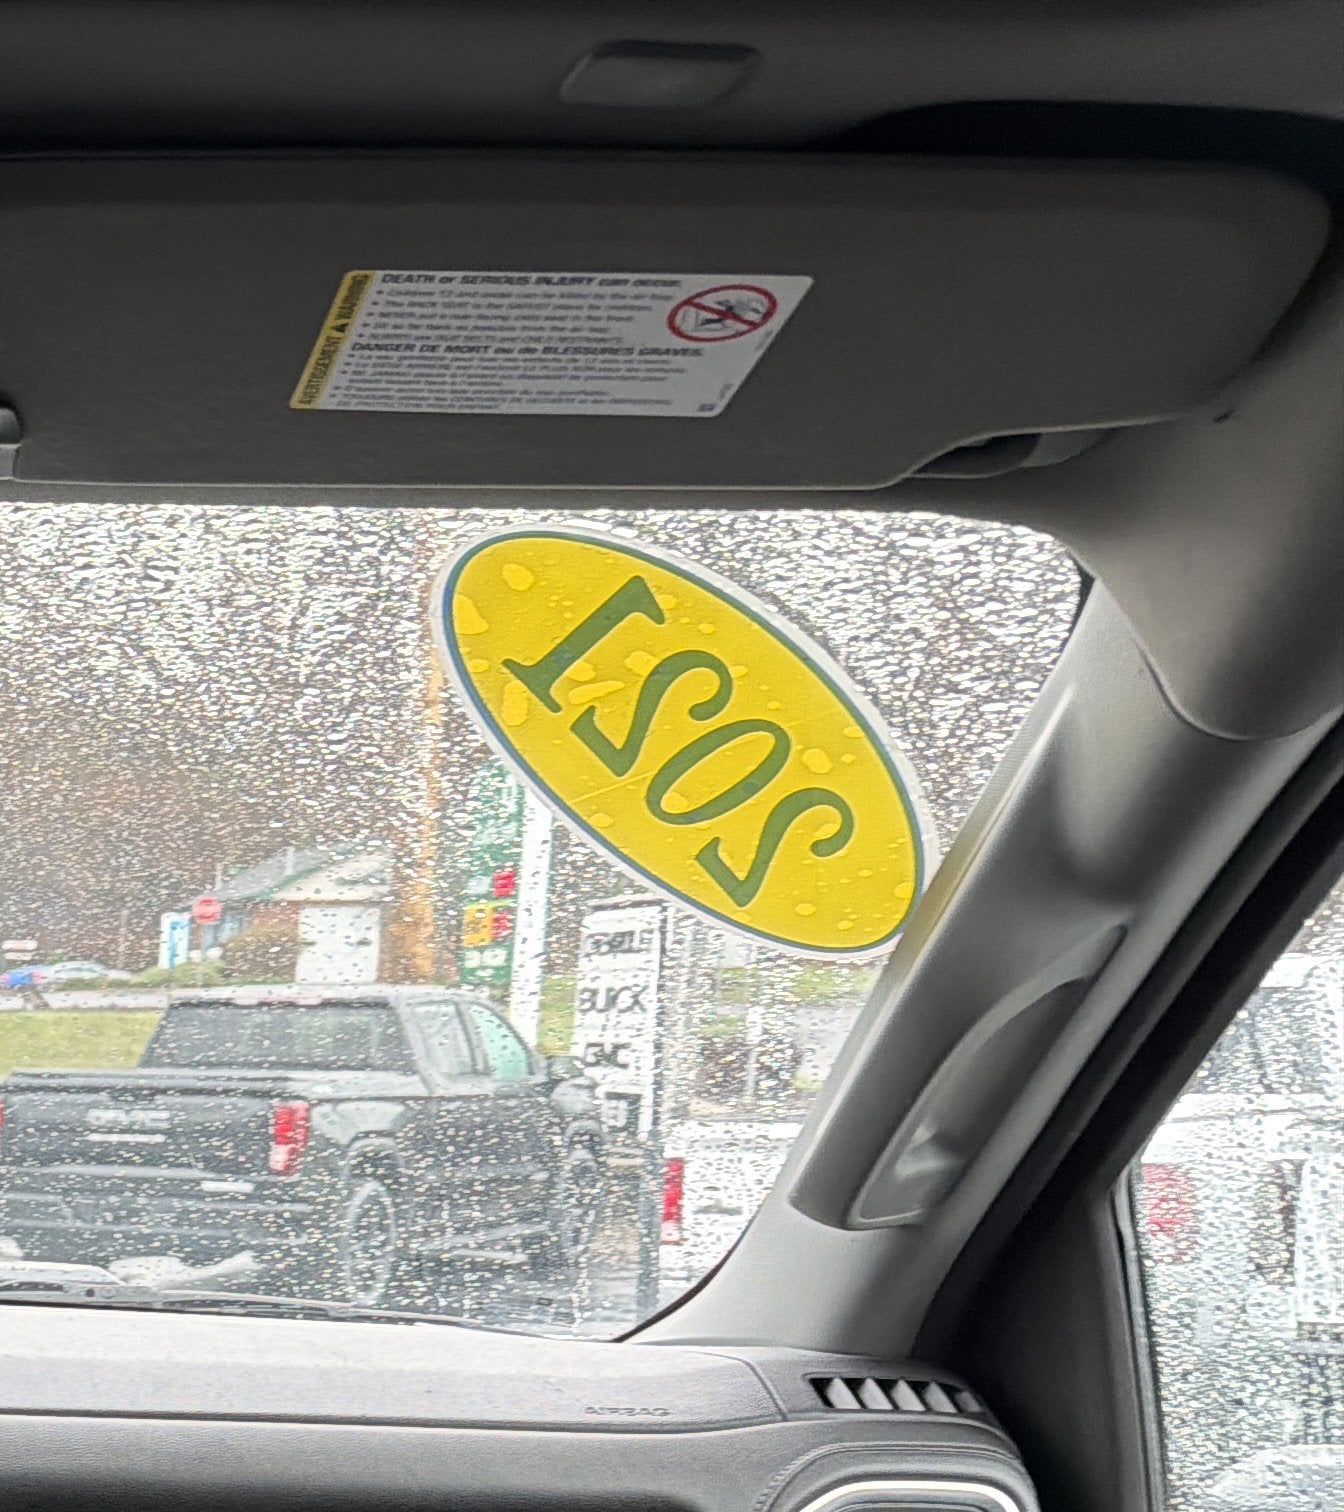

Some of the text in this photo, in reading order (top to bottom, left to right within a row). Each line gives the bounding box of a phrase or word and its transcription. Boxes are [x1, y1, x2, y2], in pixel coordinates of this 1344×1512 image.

[382, 273, 436, 284] DEATH
[351, 342, 416, 352] DANGER
[419, 344, 441, 353] DE
[443, 345, 492, 354] MORT
[541, 346, 635, 356] BLESSURES
